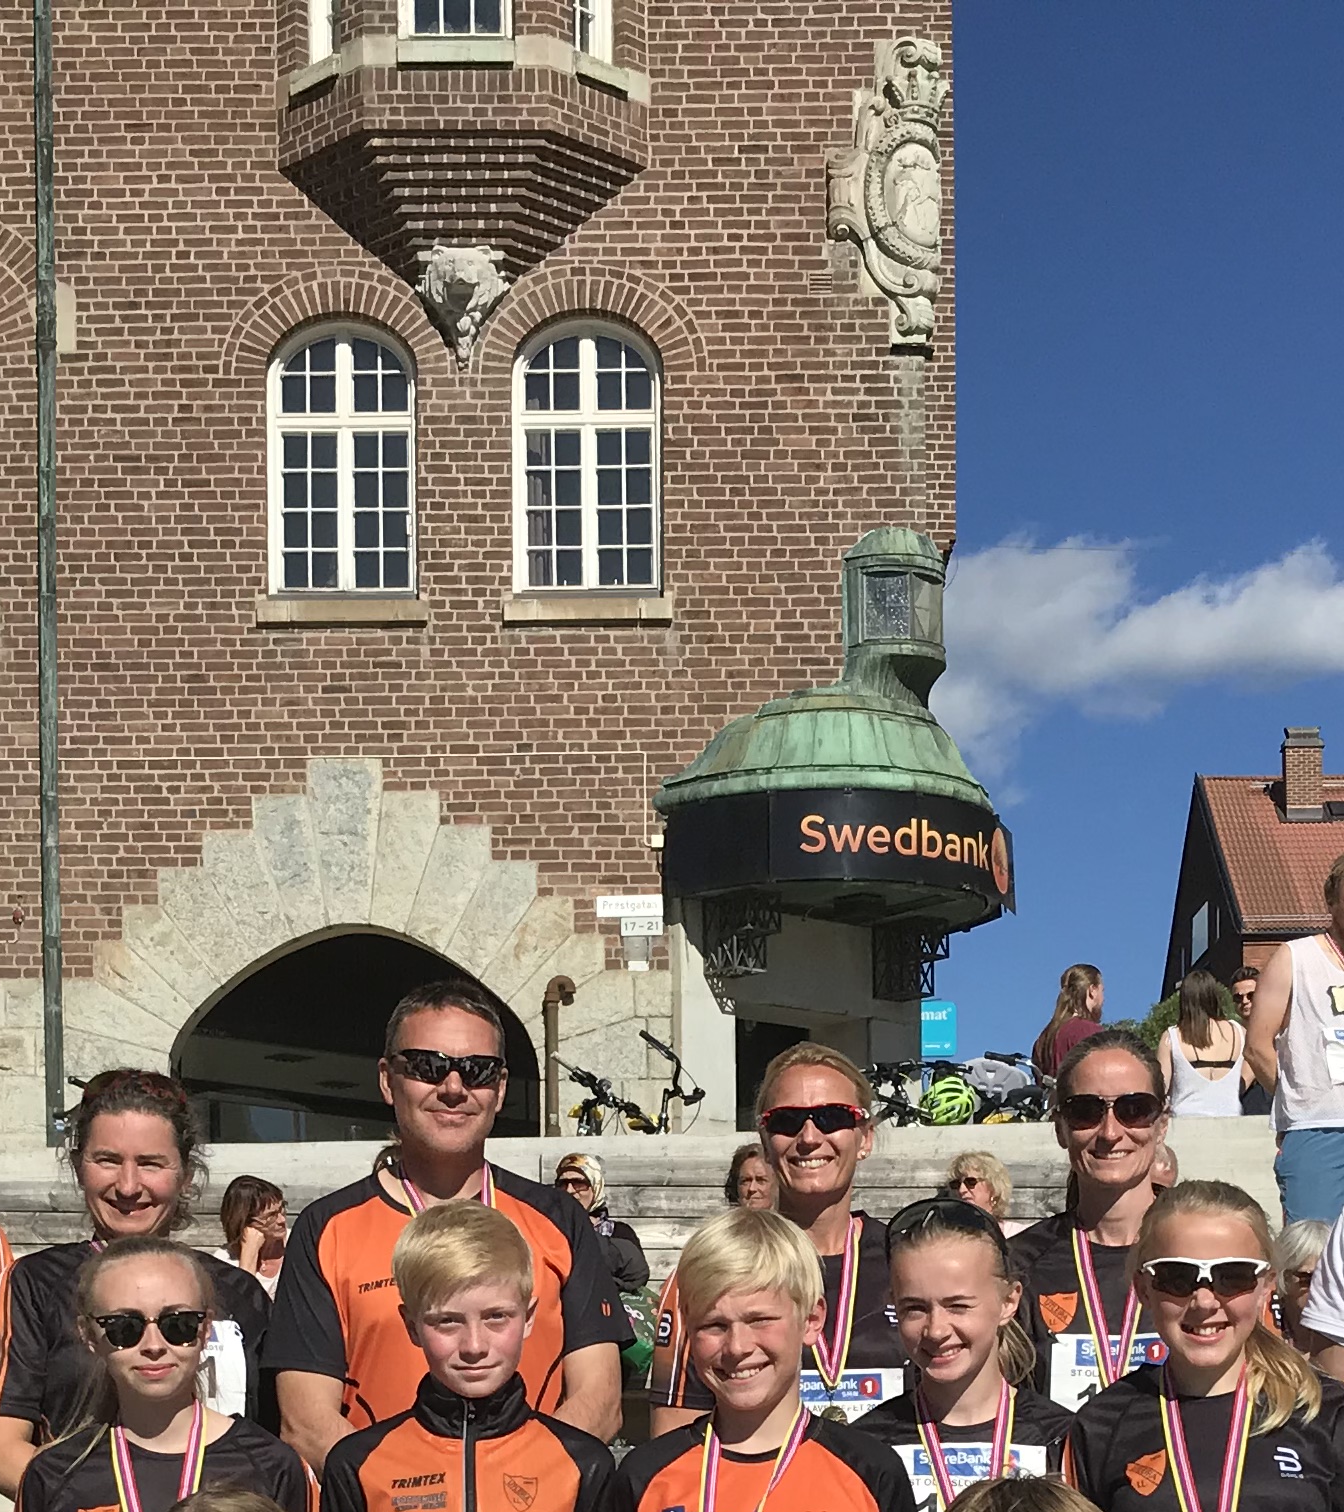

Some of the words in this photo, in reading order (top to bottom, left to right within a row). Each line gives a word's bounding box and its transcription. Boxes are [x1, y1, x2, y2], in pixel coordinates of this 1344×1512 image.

[799, 814, 990, 871] Swedbank
[358, 1277, 397, 1294] TRIMTE
[391, 1471, 446, 1489] TRIMTEX
